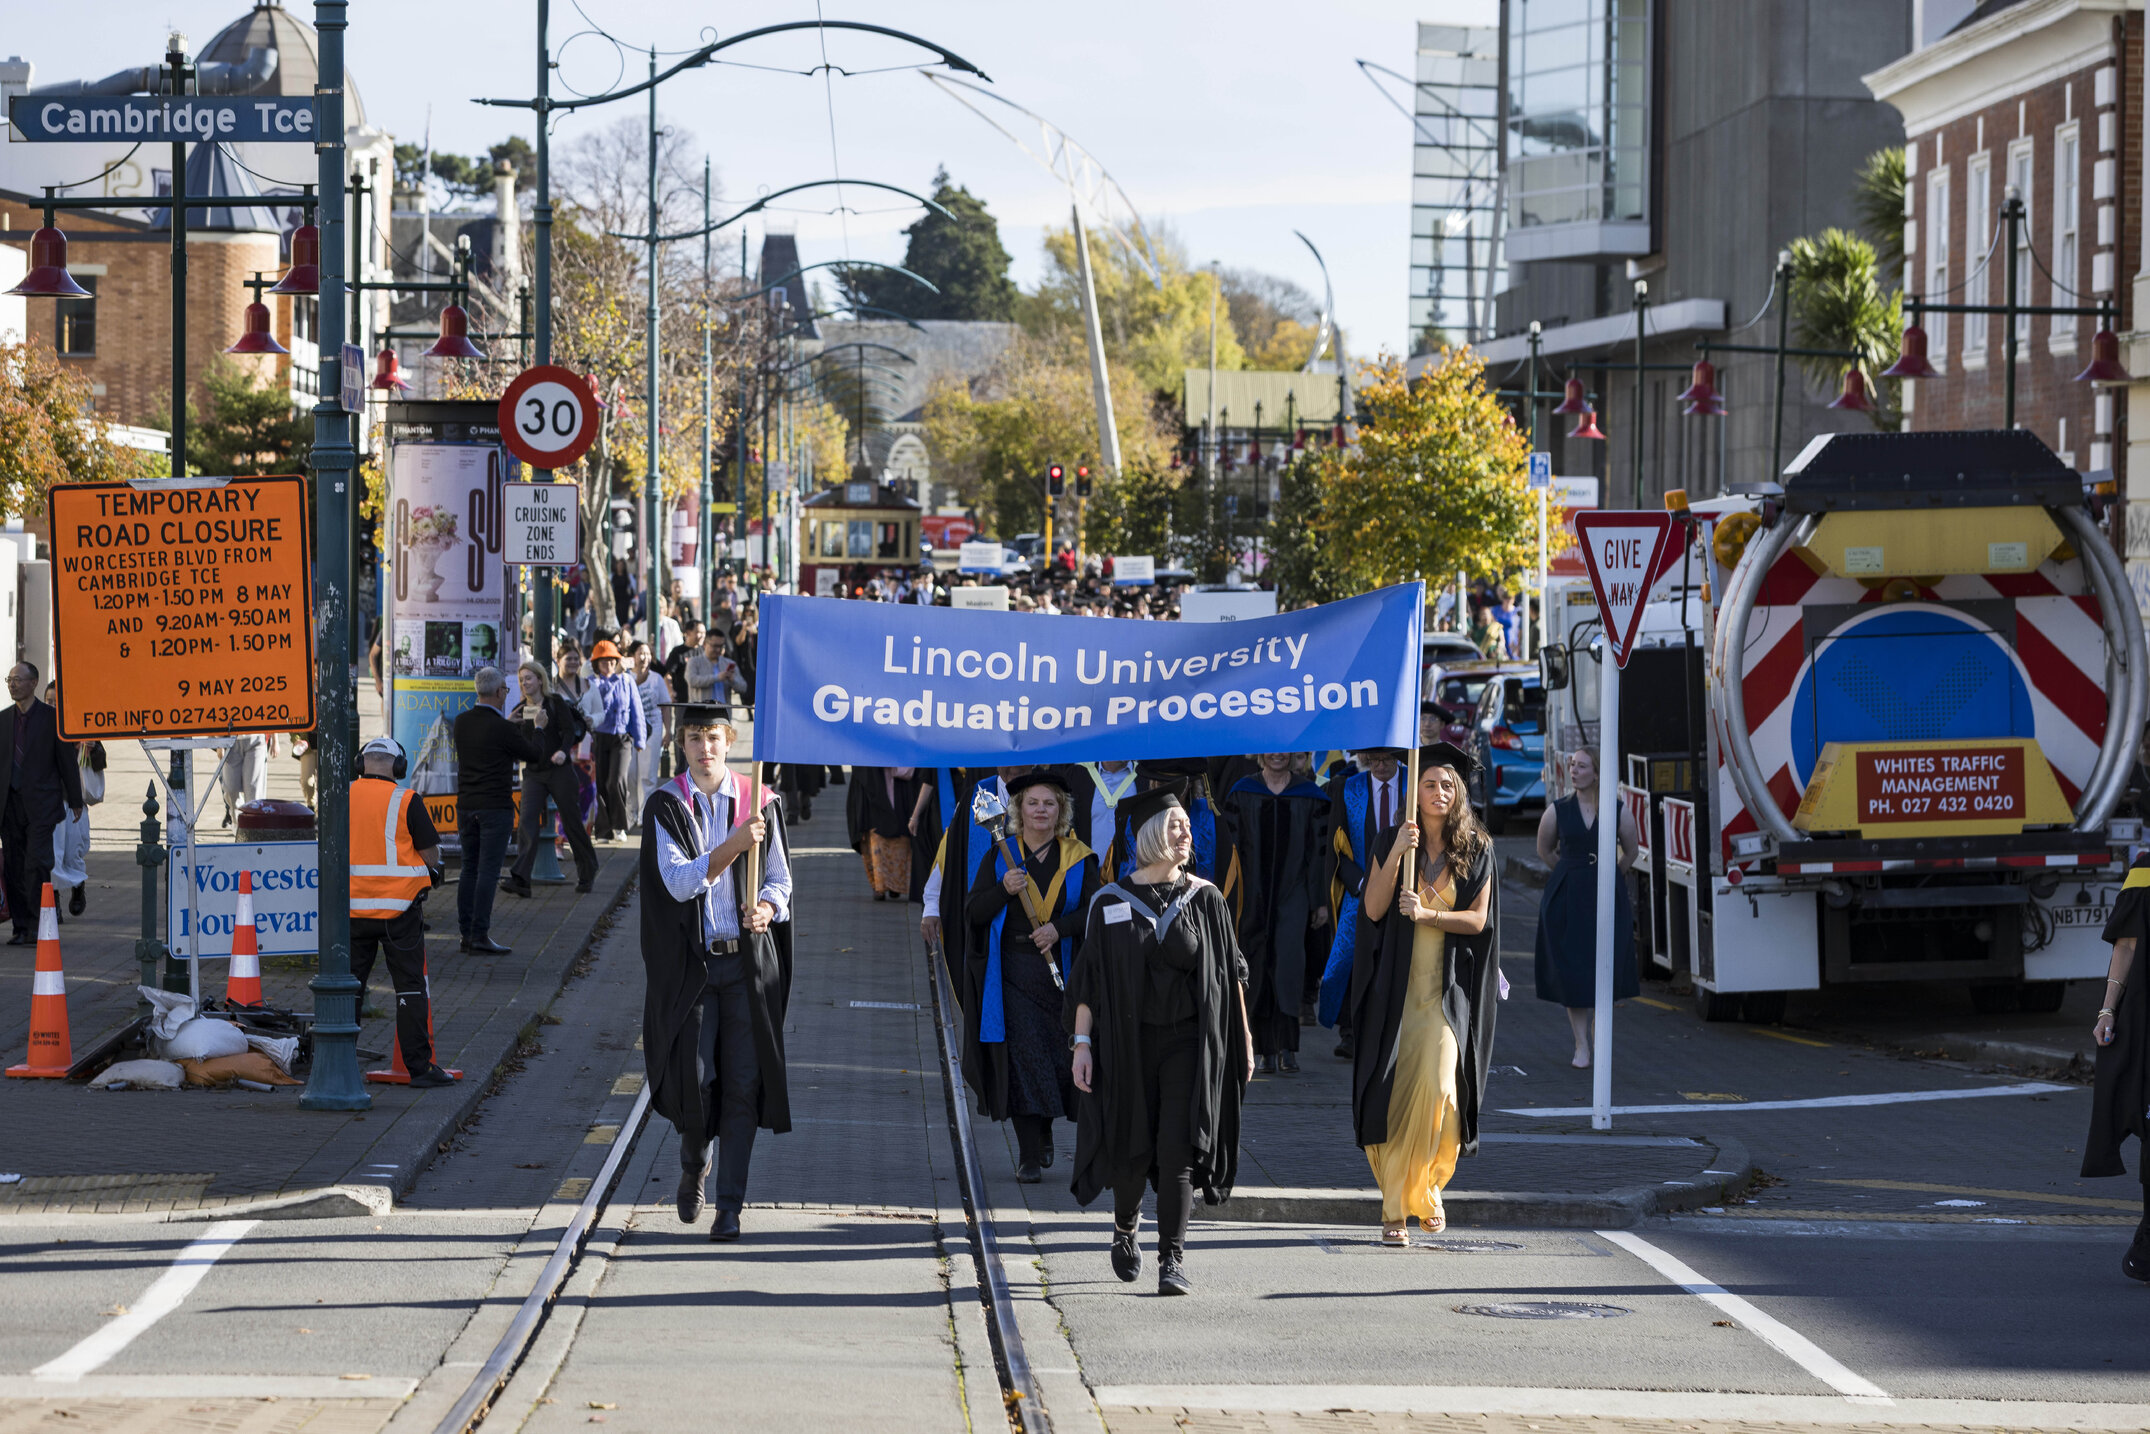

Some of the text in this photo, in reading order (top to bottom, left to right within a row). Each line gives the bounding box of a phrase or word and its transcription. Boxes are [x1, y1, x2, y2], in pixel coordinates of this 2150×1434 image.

[41, 102, 313, 141] Cambridge Tce
[522, 398, 576, 436] 30
[398, 426, 433, 435] PHANTOM
[480, 427, 500, 435] PHAN
[96, 488, 261, 516] TEMPORARY
[533, 489, 548, 504] NO
[515, 507, 566, 523] CRUISING
[77, 518, 282, 548] ROAD CLOSURE
[526, 526, 555, 542] ZONE
[64, 546, 272, 573] WORCESTER BLVD FROM
[526, 545, 555, 560] ENDS
[1604, 539, 1642, 569] GIVE
[78, 568, 221, 592] CAMBRIDGE TCE
[236, 585, 249, 604] 8
[256, 584, 292, 601] MAY
[1610, 583, 1634, 606] WAY
[107, 617, 144, 635] AND
[119, 643, 130, 658] &
[884, 632, 1309, 686] Lincoln University
[178, 676, 287, 698] 9 MAY 2025
[395, 694, 450, 711] ADAM
[812, 673, 1379, 731] Graduation Procession
[83, 704, 290, 728] FOR INFO 0274320420
[419, 723, 449, 735] THIS
[418, 738, 455, 750] GOIN
[1874, 755, 2006, 776] WHITES TRAFFIC
[1881, 775, 2000, 795] MANAGEMENT
[1869, 794, 2014, 815] PH. 027 432 0420
[181, 864, 319, 893] Worceste
